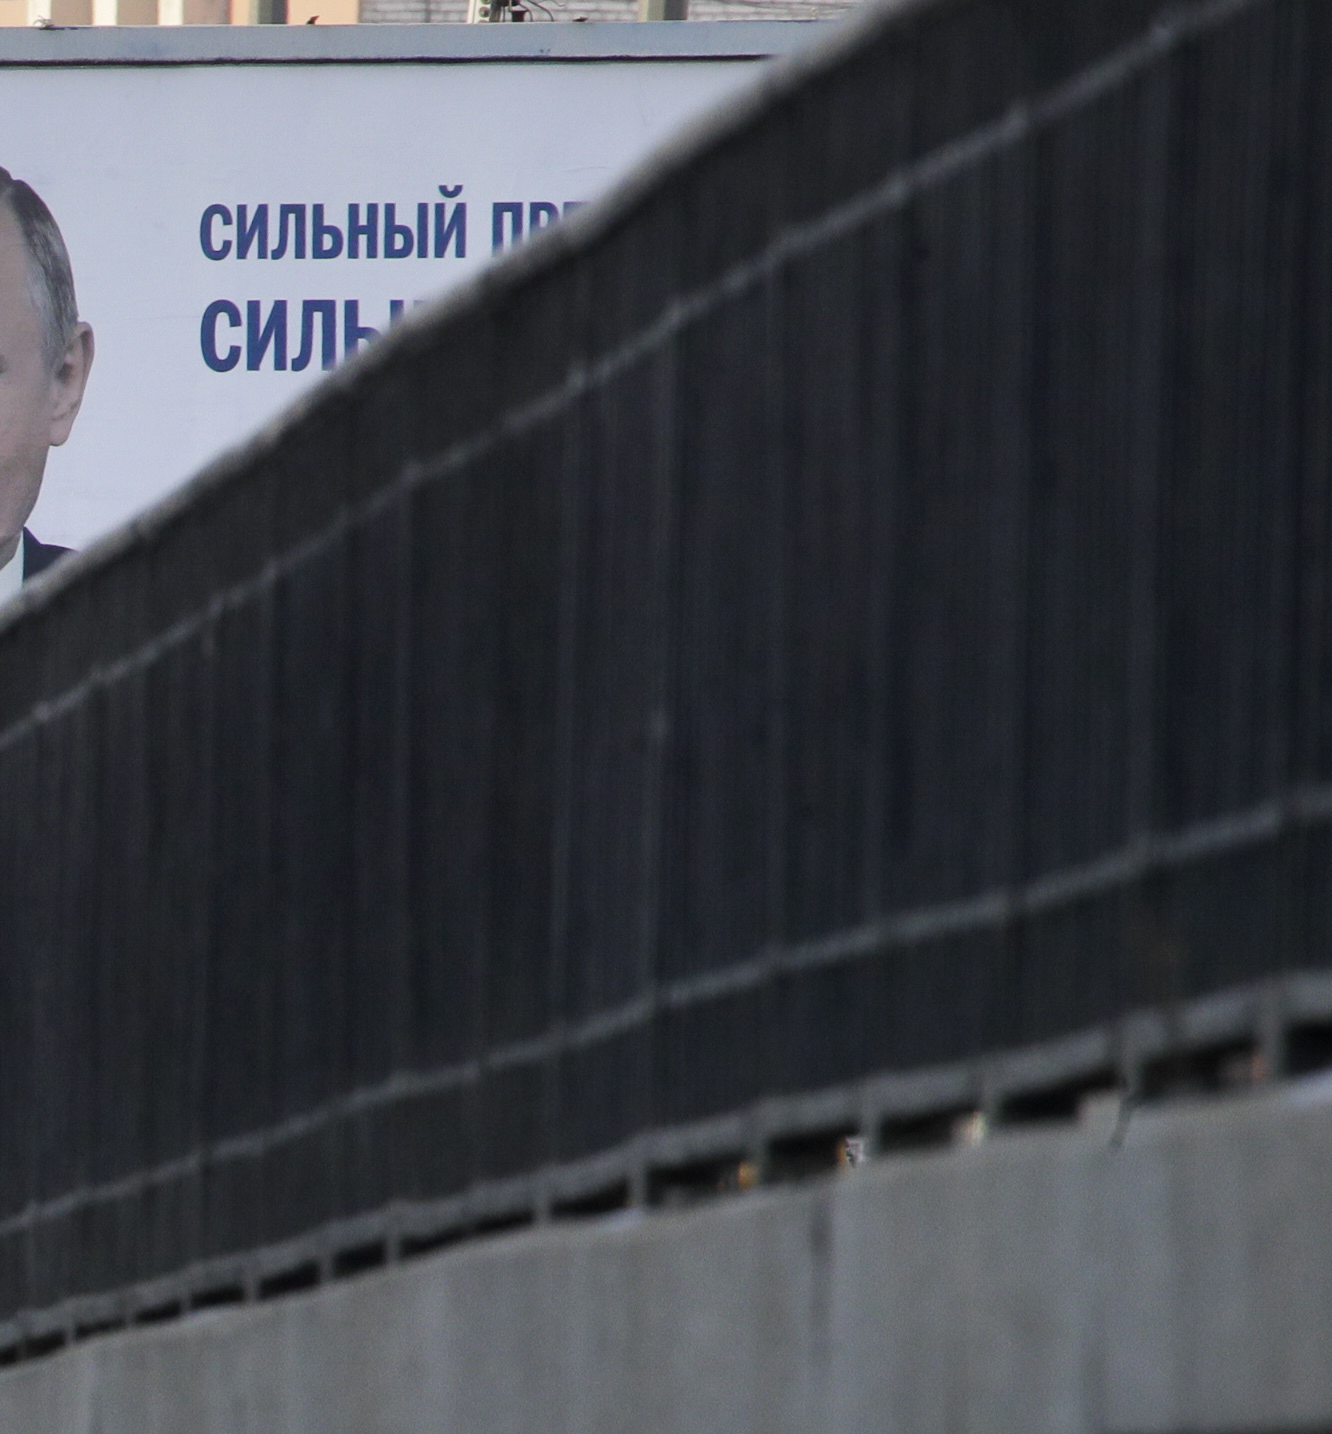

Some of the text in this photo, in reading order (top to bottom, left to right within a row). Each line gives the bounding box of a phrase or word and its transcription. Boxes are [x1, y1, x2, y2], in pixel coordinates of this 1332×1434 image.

[200, 184, 587, 261] СИЛЬНЫЙ ПР
[200, 299, 427, 373] СИЛЬ
